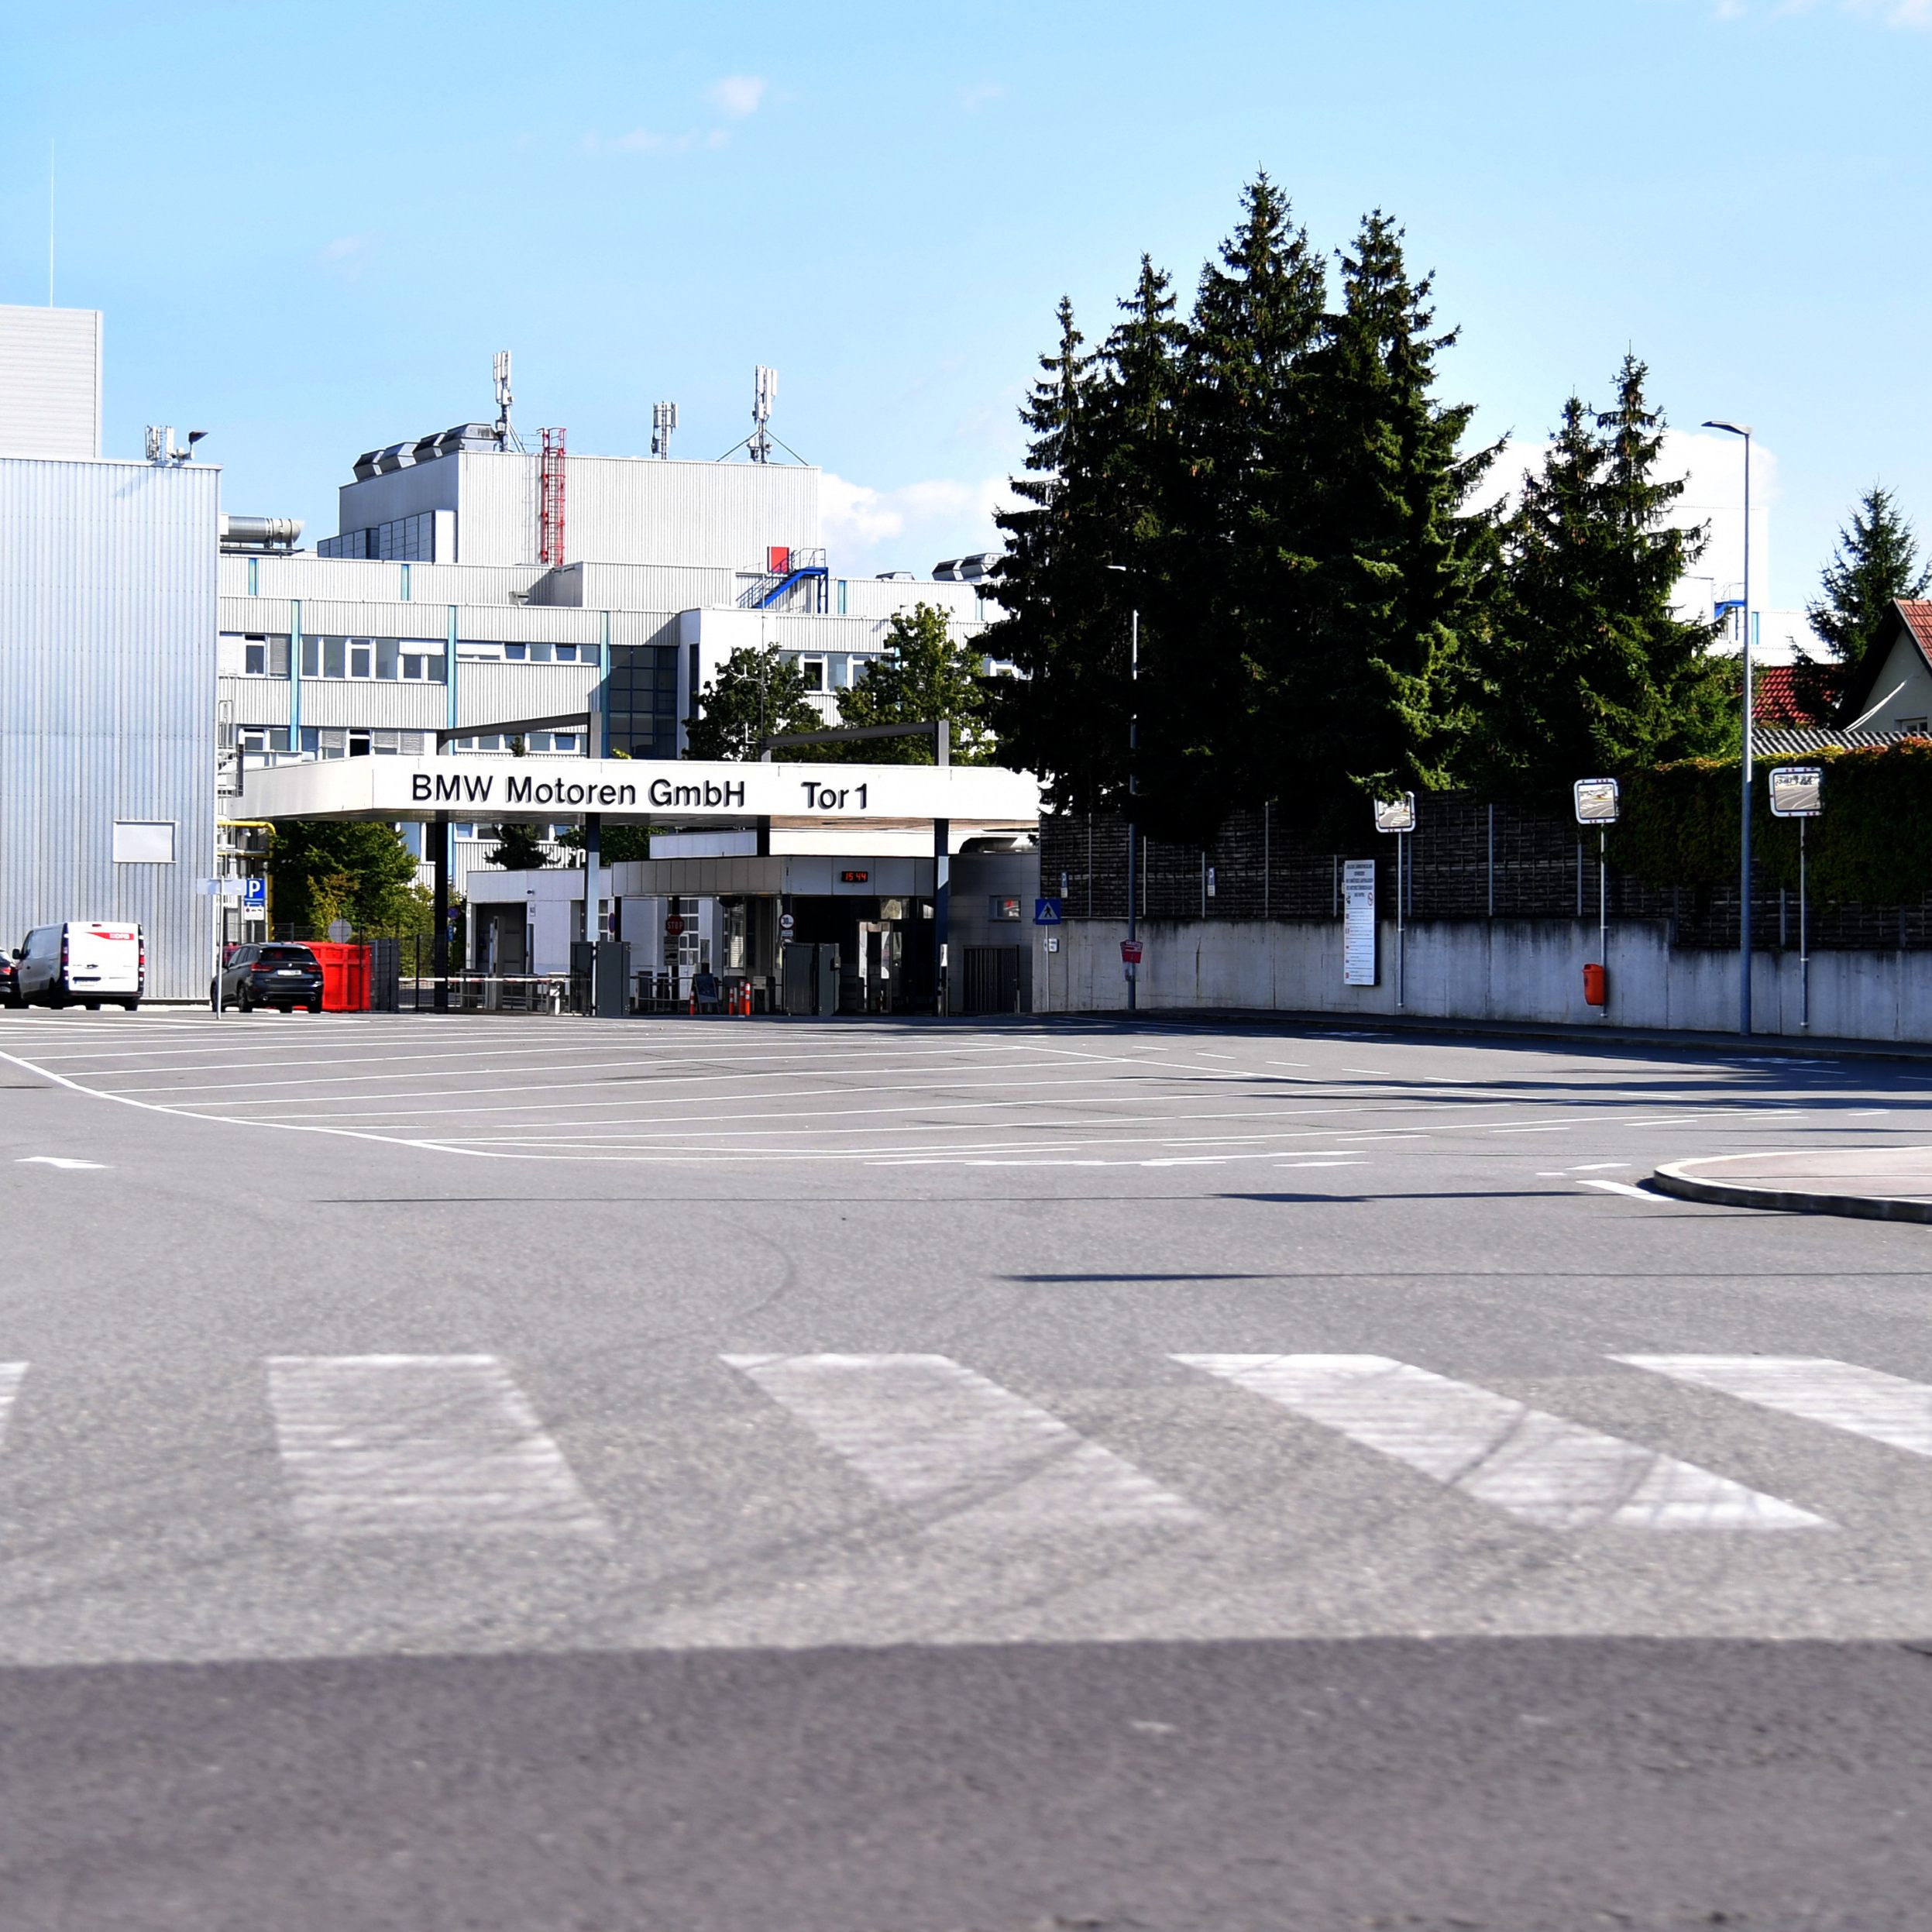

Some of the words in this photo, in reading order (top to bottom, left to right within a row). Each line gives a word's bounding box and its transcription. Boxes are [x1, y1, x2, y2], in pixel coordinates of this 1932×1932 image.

[411, 774, 493, 802] BMW
[506, 776, 636, 805] Motoren
[648, 779, 744, 807] GmbH
[800, 782, 850, 810] Tor
[854, 782, 868, 810] 1
[249, 880, 261, 898] P
[667, 921, 683, 930] STOP
